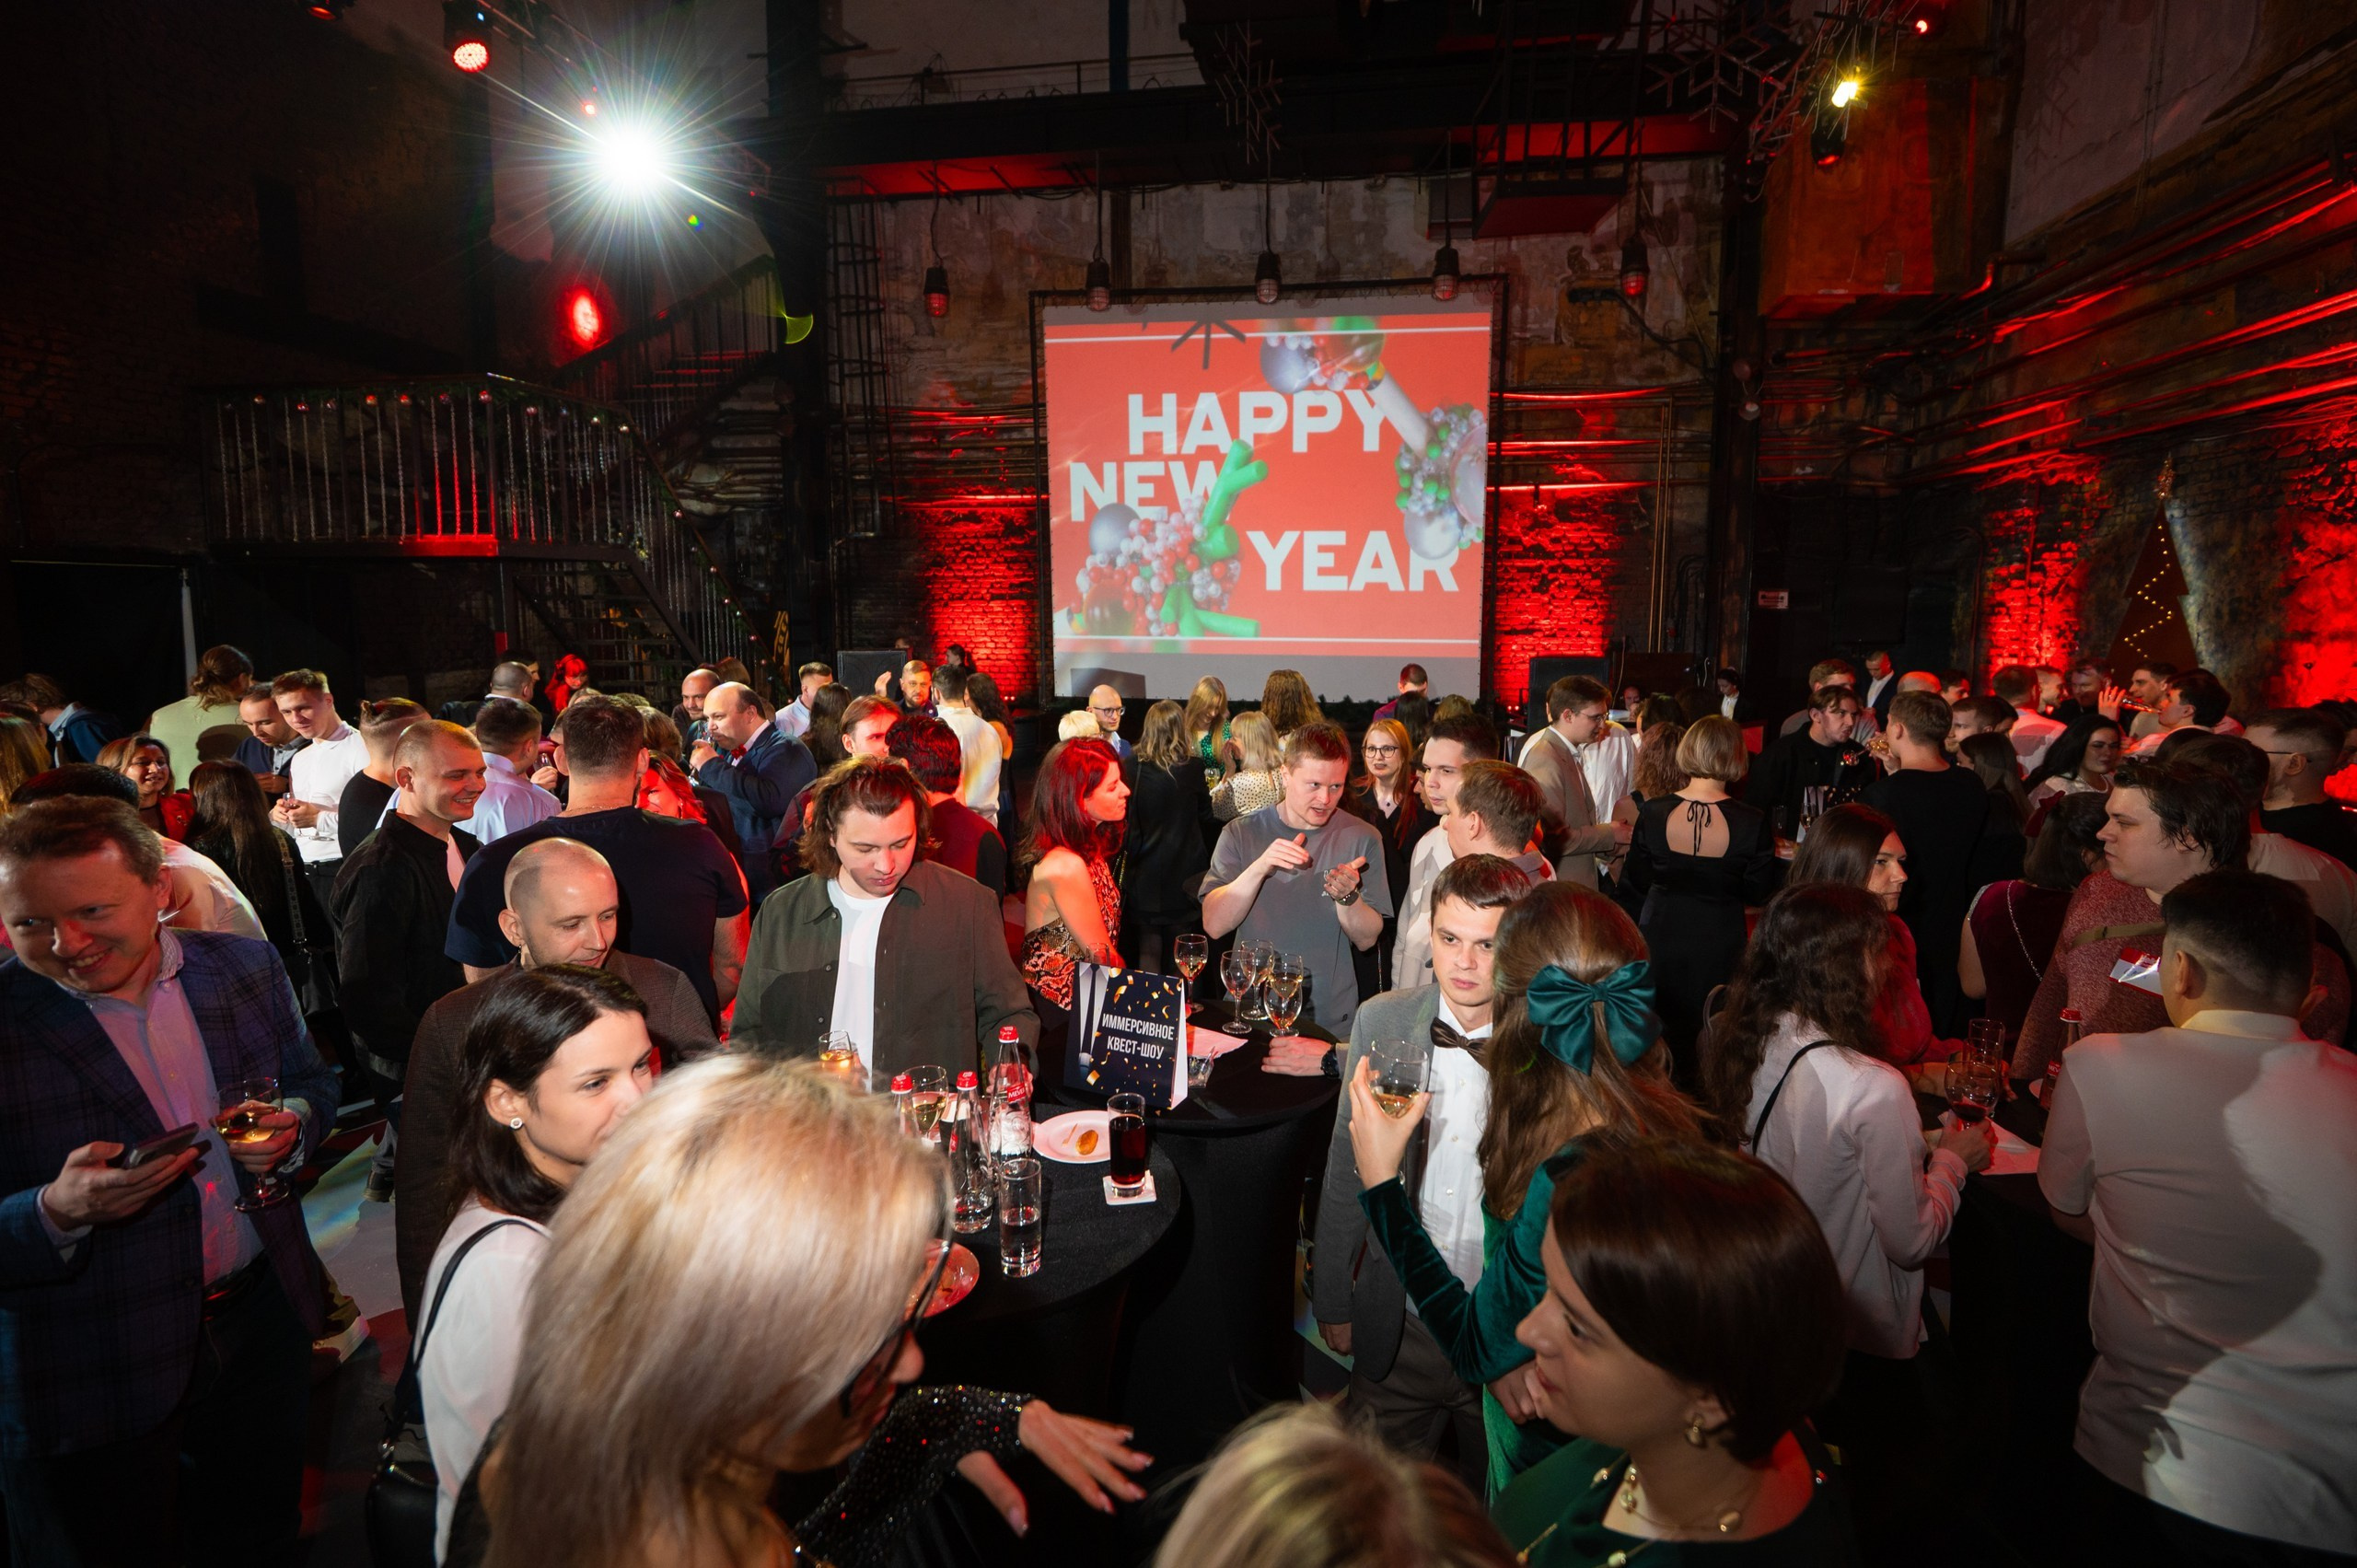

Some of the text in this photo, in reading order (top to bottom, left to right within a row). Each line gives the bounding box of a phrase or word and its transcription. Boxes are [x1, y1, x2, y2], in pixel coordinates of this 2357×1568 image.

[1128, 389, 1398, 455] HAPPY
[1246, 530, 1460, 592] YEAR
[1102, 1014, 1175, 1040] ИММЕРСИВНОЕ
[1107, 1036, 1165, 1060] КВЕСТ-ШОУ
